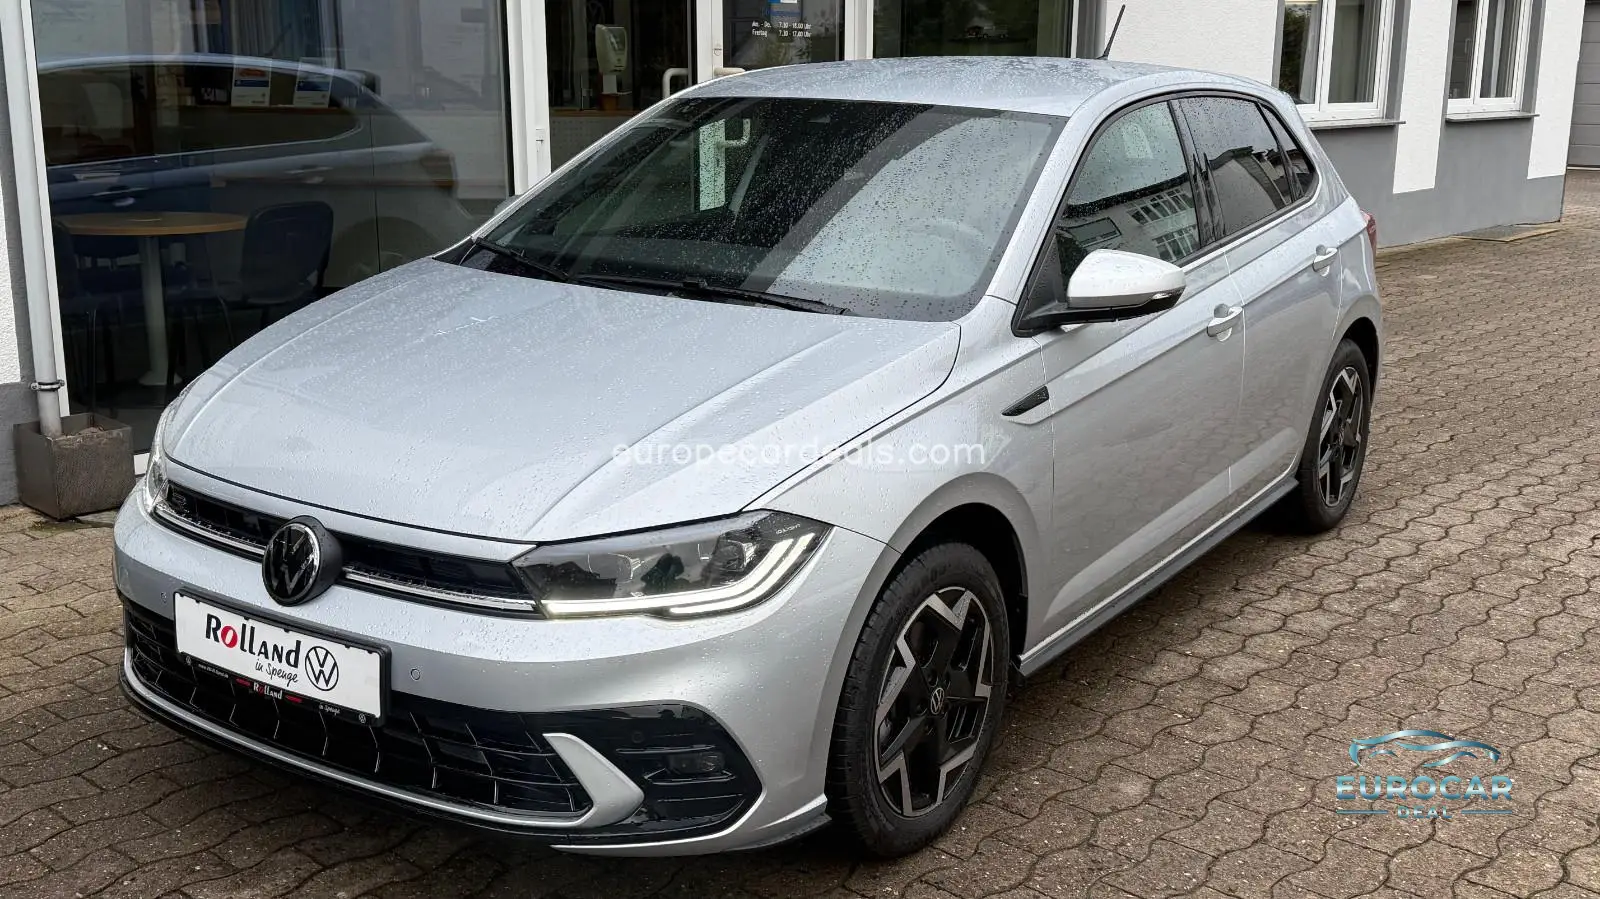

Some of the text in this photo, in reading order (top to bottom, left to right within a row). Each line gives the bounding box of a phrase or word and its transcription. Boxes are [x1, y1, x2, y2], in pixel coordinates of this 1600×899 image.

[752, 29, 768, 37] Freitag
[255, 659, 299, 687] in Spenge
